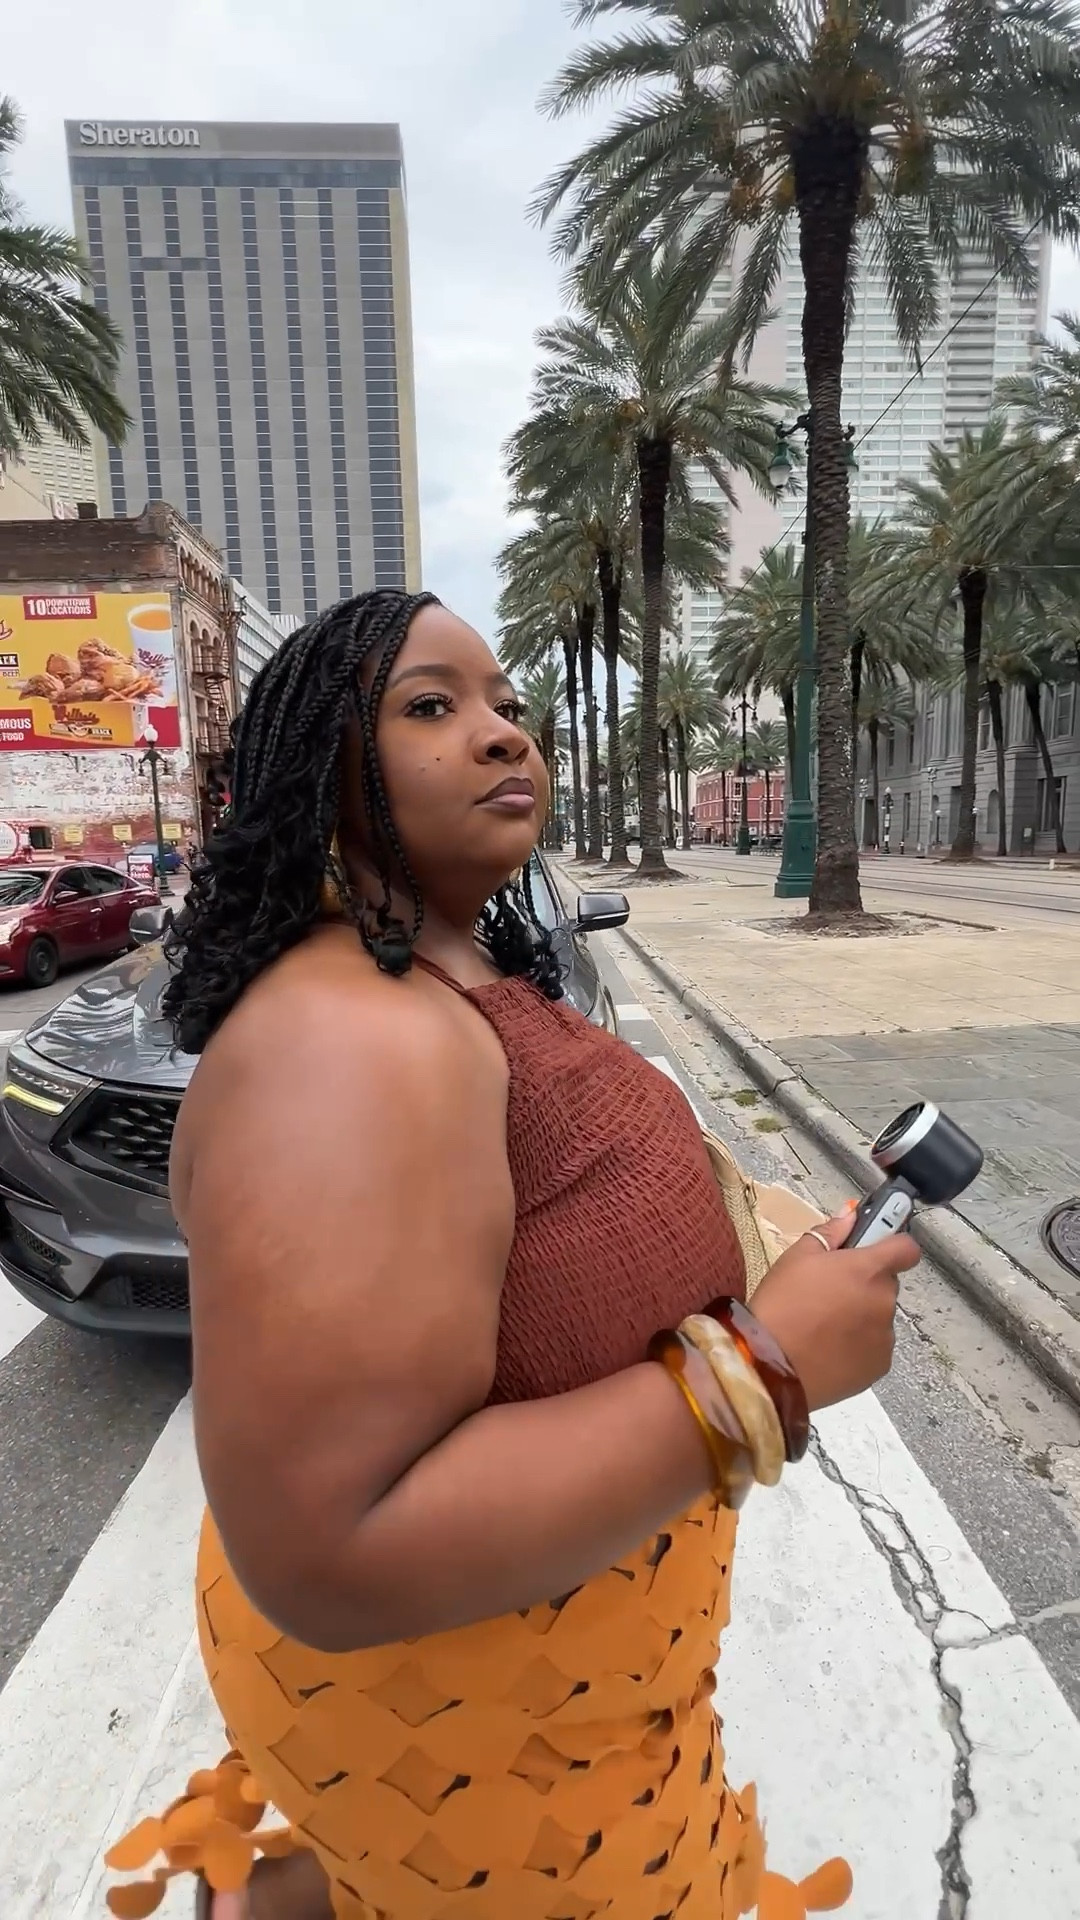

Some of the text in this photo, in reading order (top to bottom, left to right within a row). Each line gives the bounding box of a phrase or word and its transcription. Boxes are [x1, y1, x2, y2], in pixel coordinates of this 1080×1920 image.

[80, 121, 200, 147] Sheraton
[27, 598, 90, 615] 10 DOWNTOWN
[46, 606, 92, 615] LOCATIONS
[0, 718, 32, 729] MOUS
[2, 732, 24, 741] FOOD
